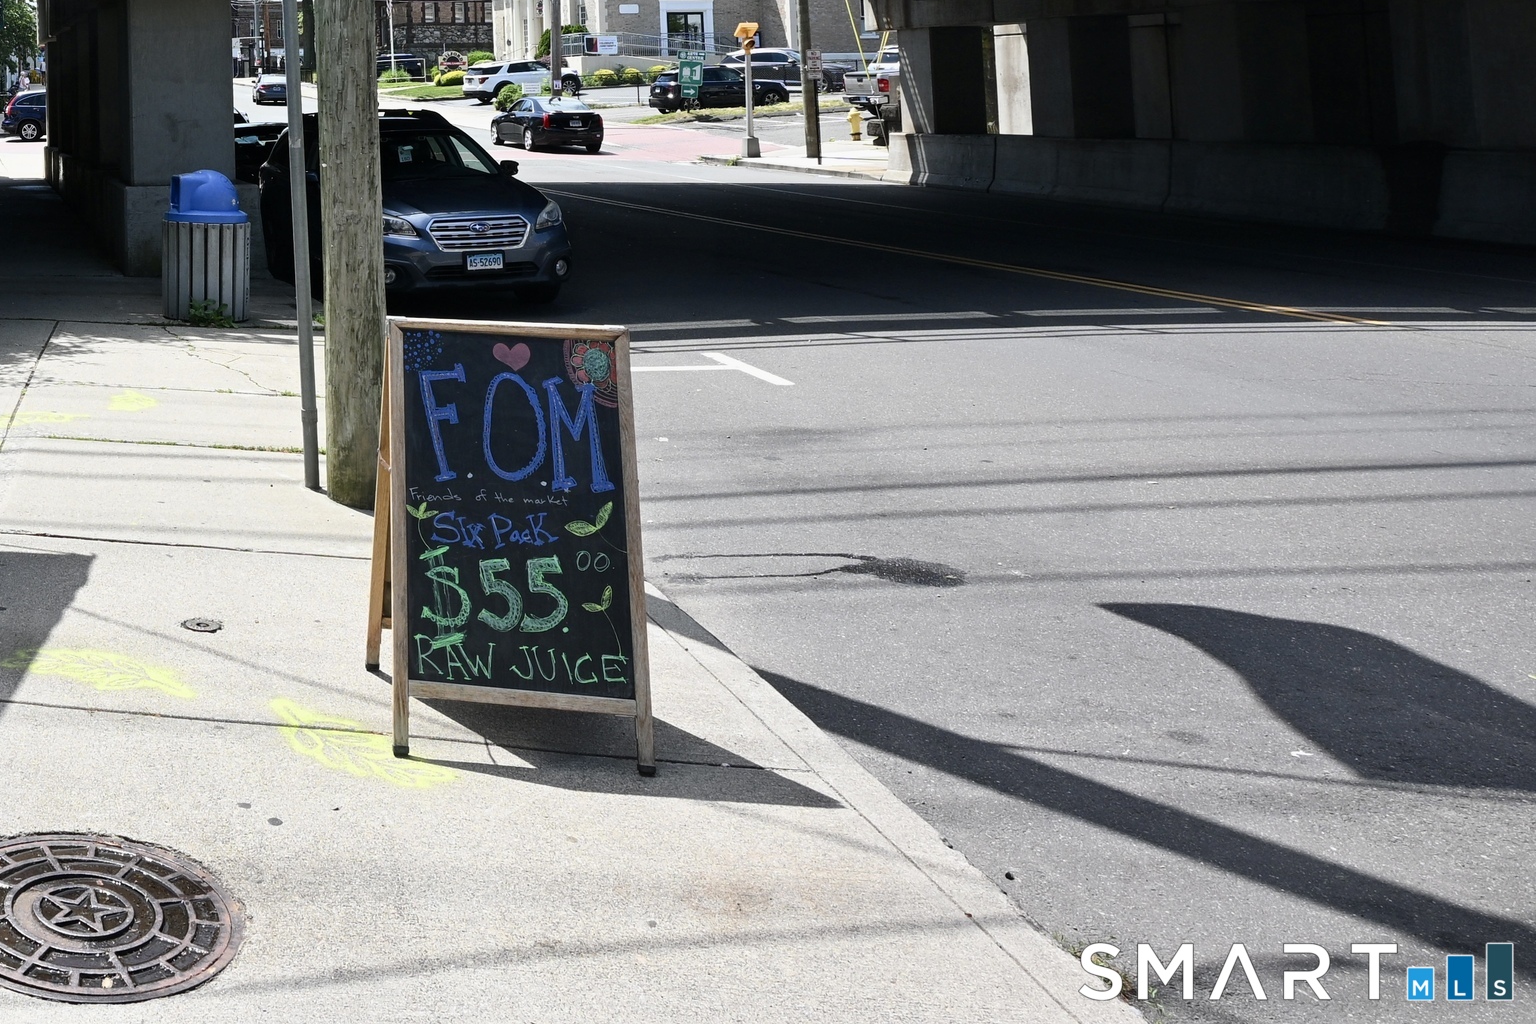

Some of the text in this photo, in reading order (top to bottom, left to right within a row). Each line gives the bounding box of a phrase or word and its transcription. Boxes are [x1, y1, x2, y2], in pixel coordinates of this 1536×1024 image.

[409, 487, 462, 502] Friends
[475, 488, 487, 502] of
[495, 491, 514, 504] the
[414, 634, 629, 685] RAW JUICE
